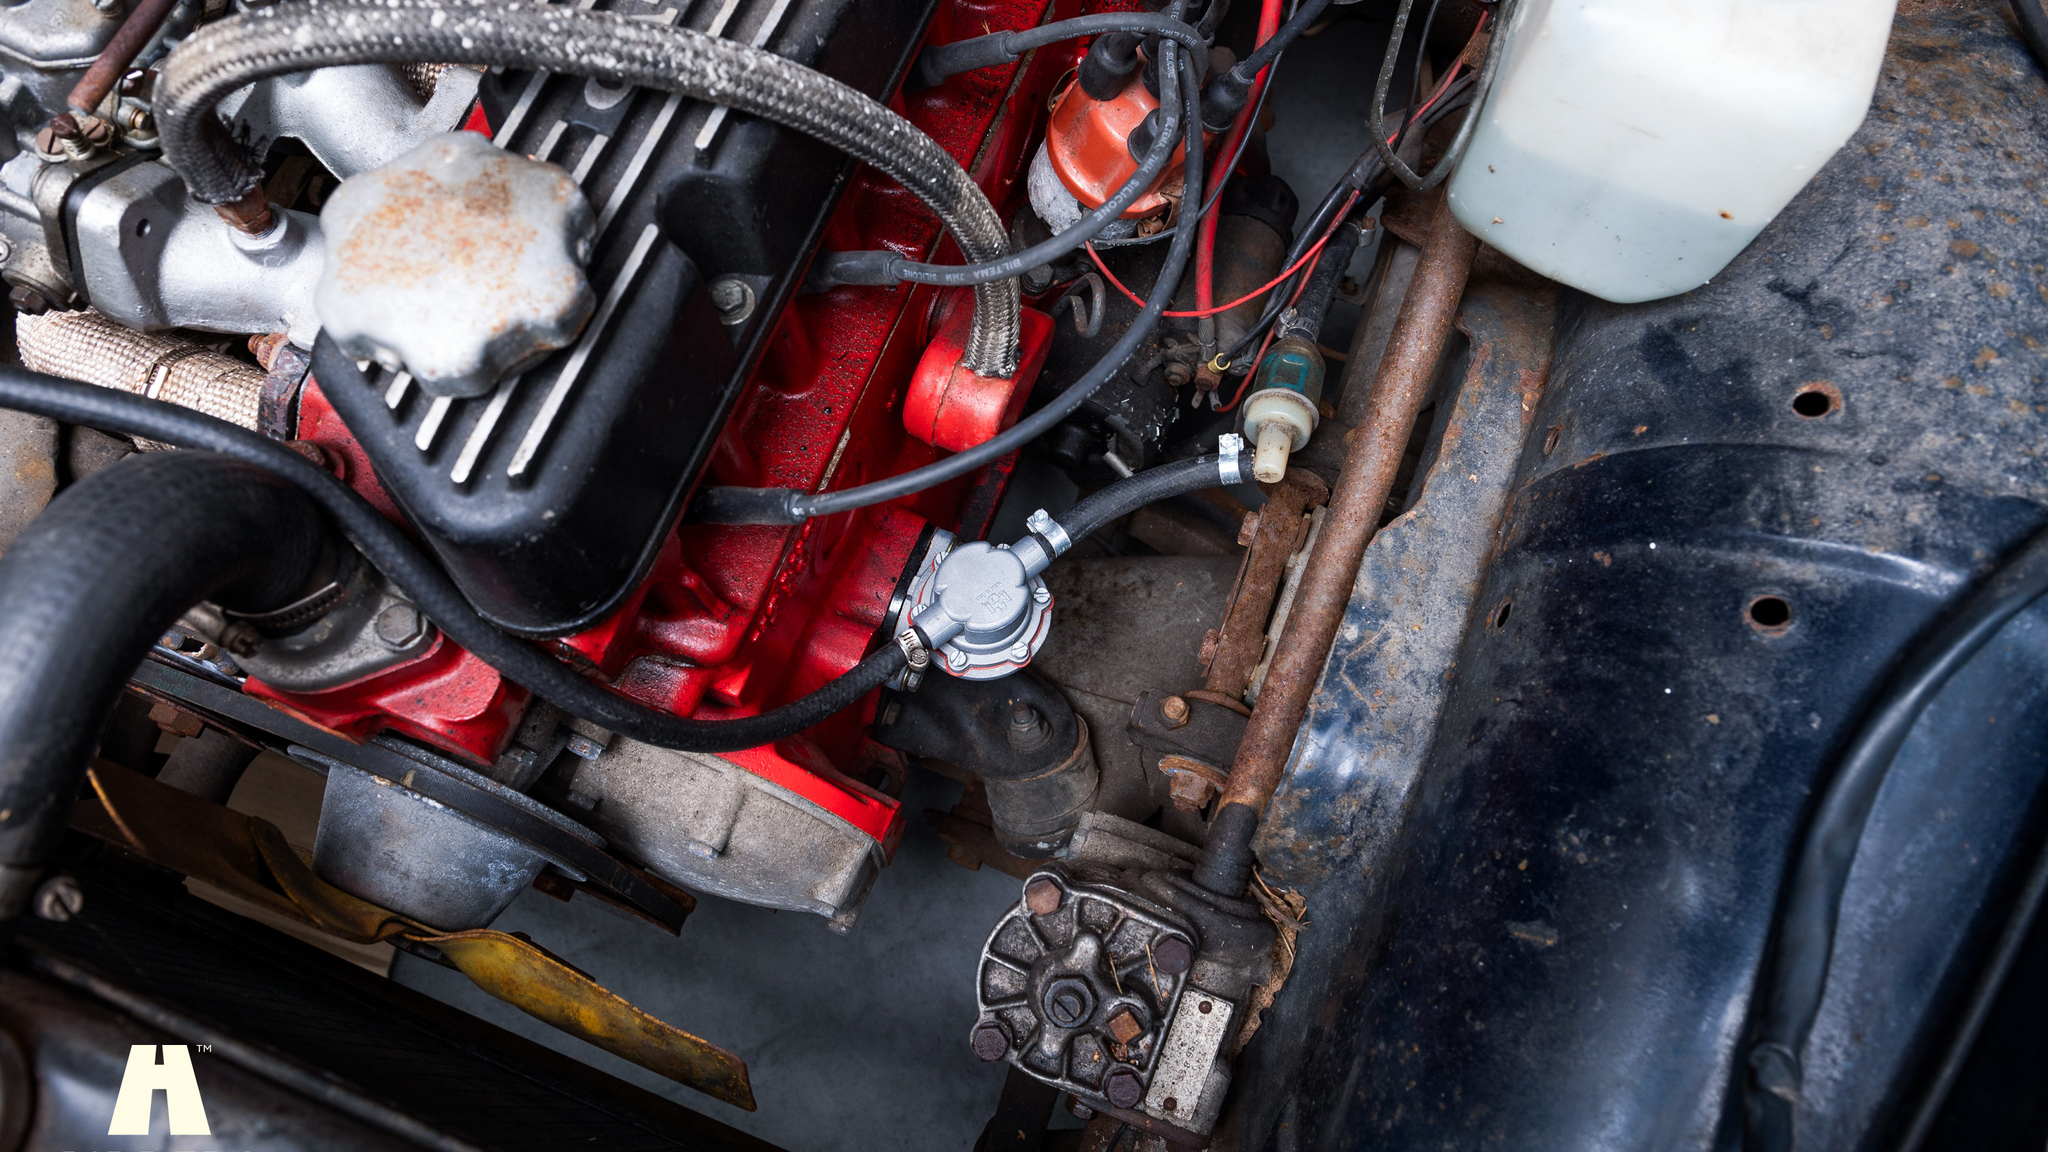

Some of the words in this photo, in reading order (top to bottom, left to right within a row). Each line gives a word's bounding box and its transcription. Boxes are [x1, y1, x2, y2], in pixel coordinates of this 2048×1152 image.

[1170, 1, 1182, 20] BILTE
[1155, 117, 1175, 150] BILTEMA
[1093, 179, 1140, 222] SILICONE
[902, 269, 938, 281] SILICONE
[945, 273, 965, 281] 7MM
[973, 258, 1022, 279] BILTEMA
